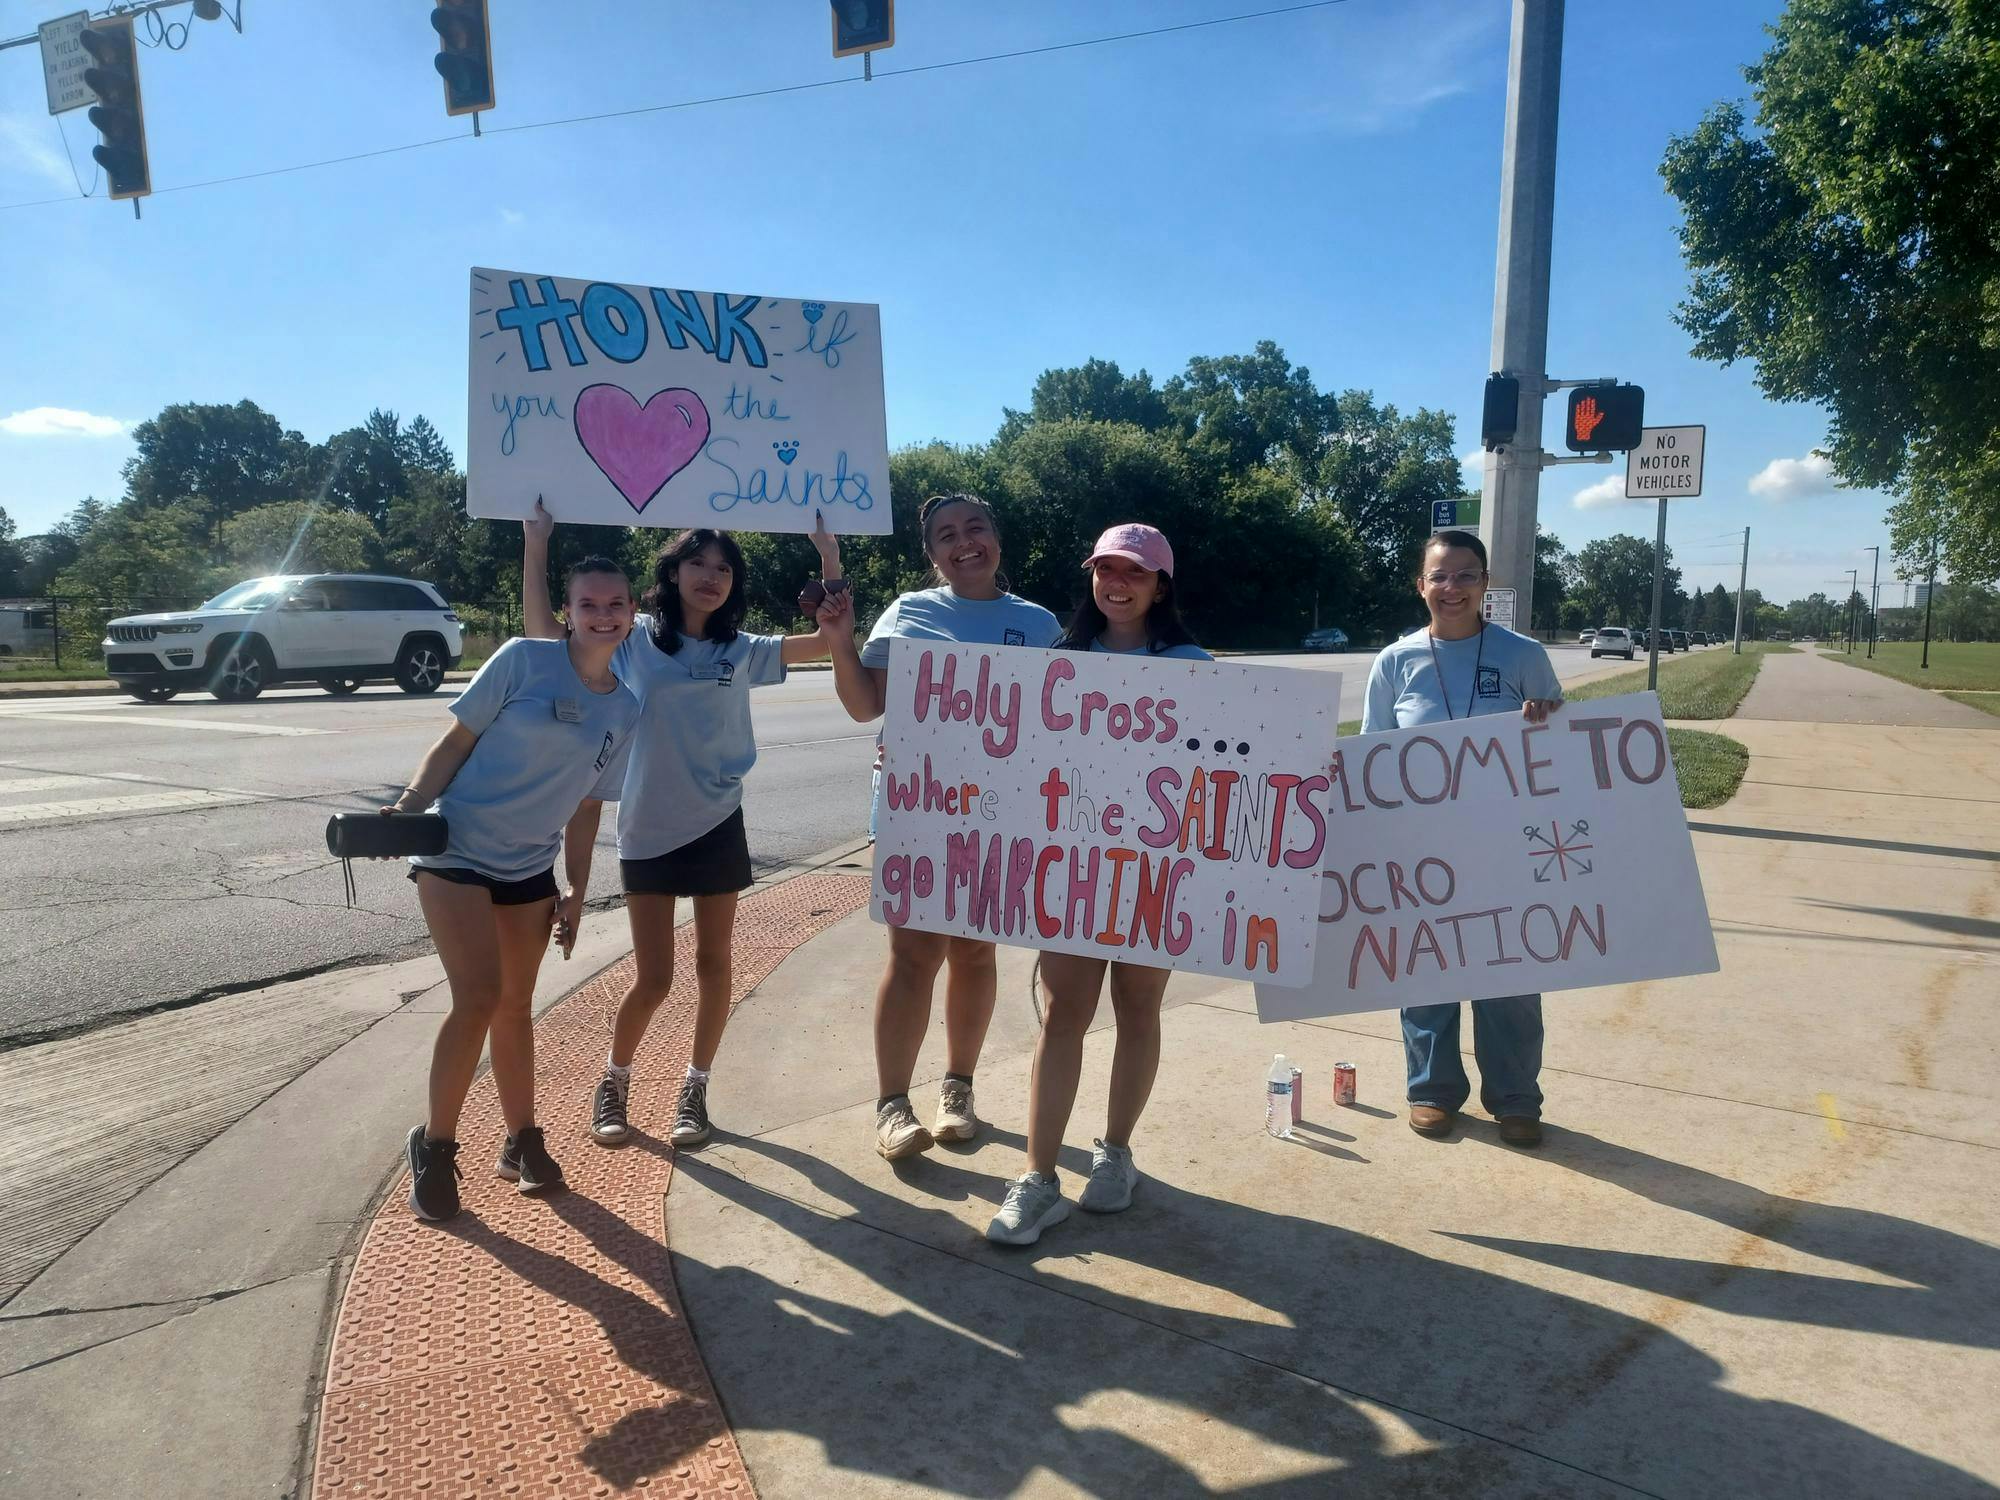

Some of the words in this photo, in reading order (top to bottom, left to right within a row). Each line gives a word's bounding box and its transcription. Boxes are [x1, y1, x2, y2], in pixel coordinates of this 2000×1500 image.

[54, 38, 79, 56] YIELD
[496, 276, 769, 373] HONK
[795, 302, 857, 369] if
[492, 392, 566, 457] you
[722, 381, 791, 421] the
[1656, 435, 1676, 450] NO
[706, 438, 874, 513] Saints
[1636, 474, 1692, 490] VEHICLES
[1639, 455, 1690, 470] MOTOR
[913, 649, 1022, 759] Holy
[1336, 723, 1560, 813] LCOME
[1568, 716, 1667, 791] TO
[887, 753, 1000, 822] where
[1039, 766, 1125, 836] the
[1137, 766, 1330, 869] SAINTS
[882, 853, 935, 928] go
[945, 829, 1196, 957] MARCHING
[1222, 891, 1280, 974] in
[1318, 856, 1456, 923] OCRO
[1348, 903, 1607, 990] NATION
